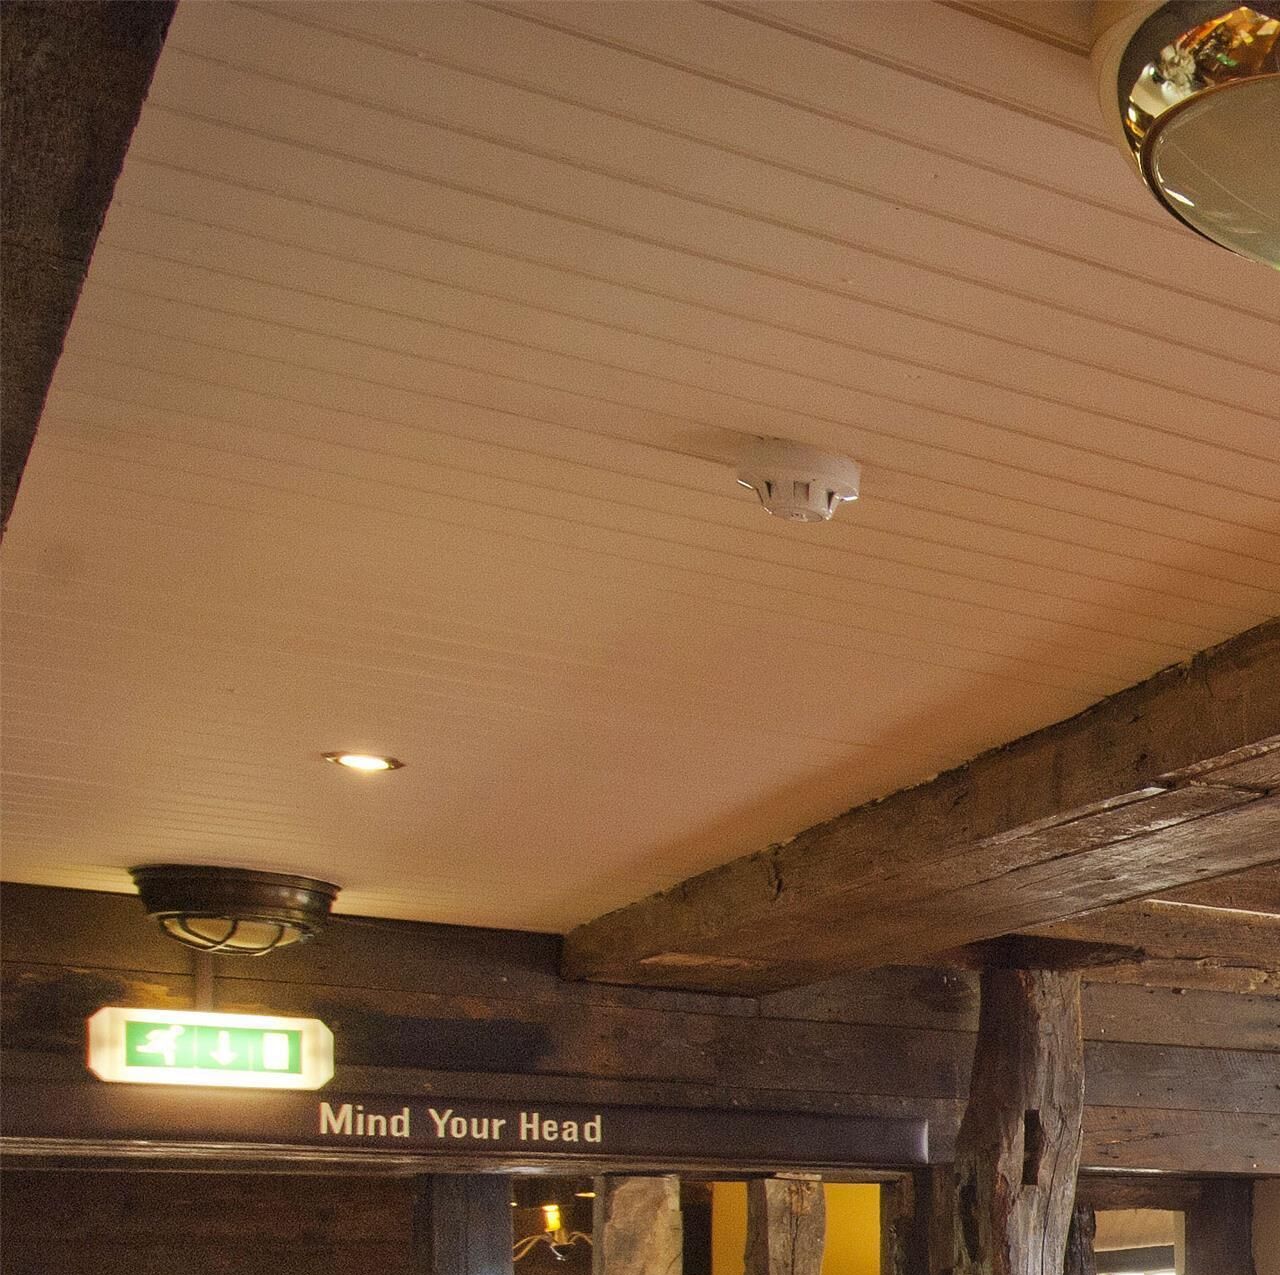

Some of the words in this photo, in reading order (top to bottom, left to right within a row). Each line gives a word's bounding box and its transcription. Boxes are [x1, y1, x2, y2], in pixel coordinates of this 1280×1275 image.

[319, 1102, 410, 1138] Mind
[428, 1108, 506, 1139] Your
[519, 1112, 602, 1143] Head
